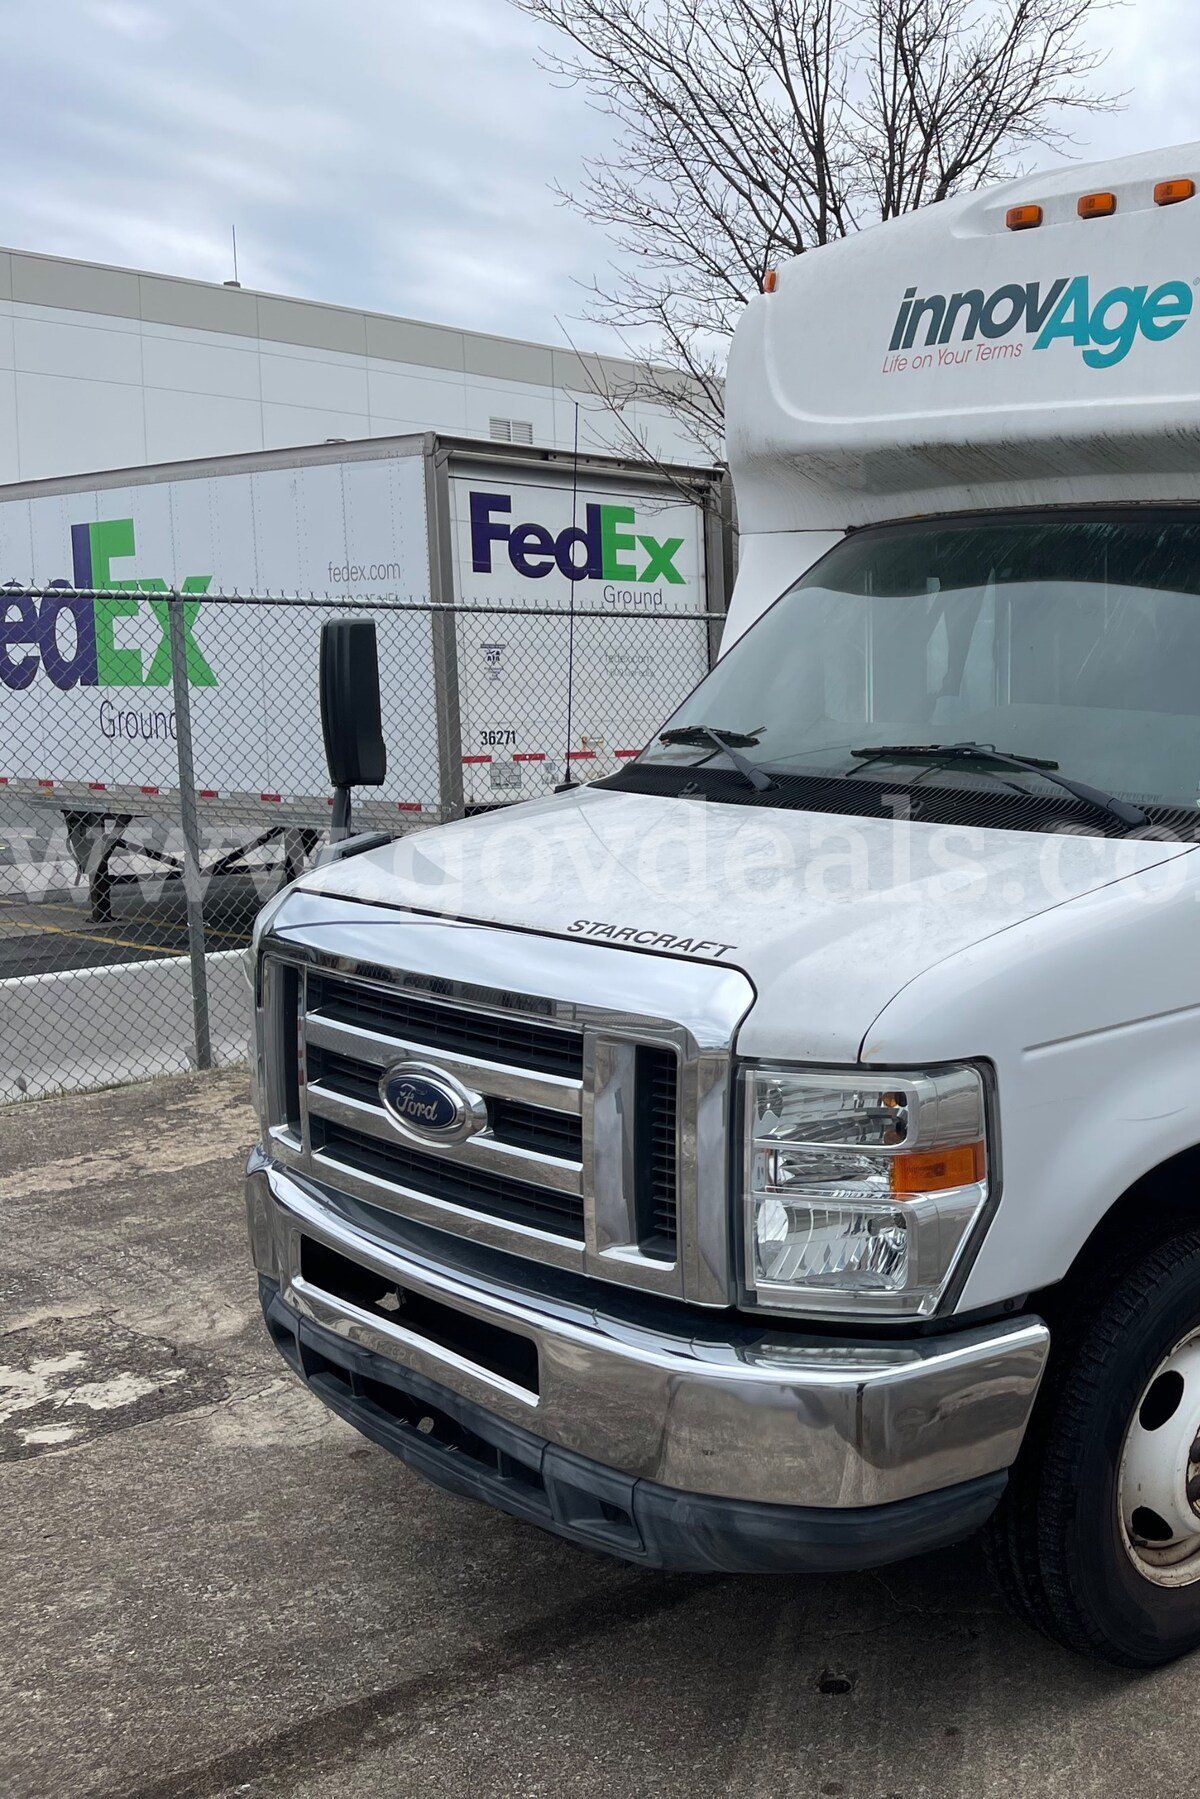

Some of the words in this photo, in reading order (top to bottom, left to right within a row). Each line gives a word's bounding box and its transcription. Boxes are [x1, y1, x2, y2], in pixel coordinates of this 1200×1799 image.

[888, 275, 1193, 370] innovAge
[882, 355, 908, 373] Life
[912, 354, 933, 369] on
[937, 347, 972, 367] Your
[976, 343, 1023, 362] Terms
[469, 491, 687, 585] FedEx
[328, 561, 401, 582] fedex.com
[0, 518, 220, 691] edEx
[603, 585, 663, 606] Ground
[480, 730, 517, 746] 36271
[566, 919, 738, 959] STARCRAFT
[396, 1083, 438, 1121] Ford
